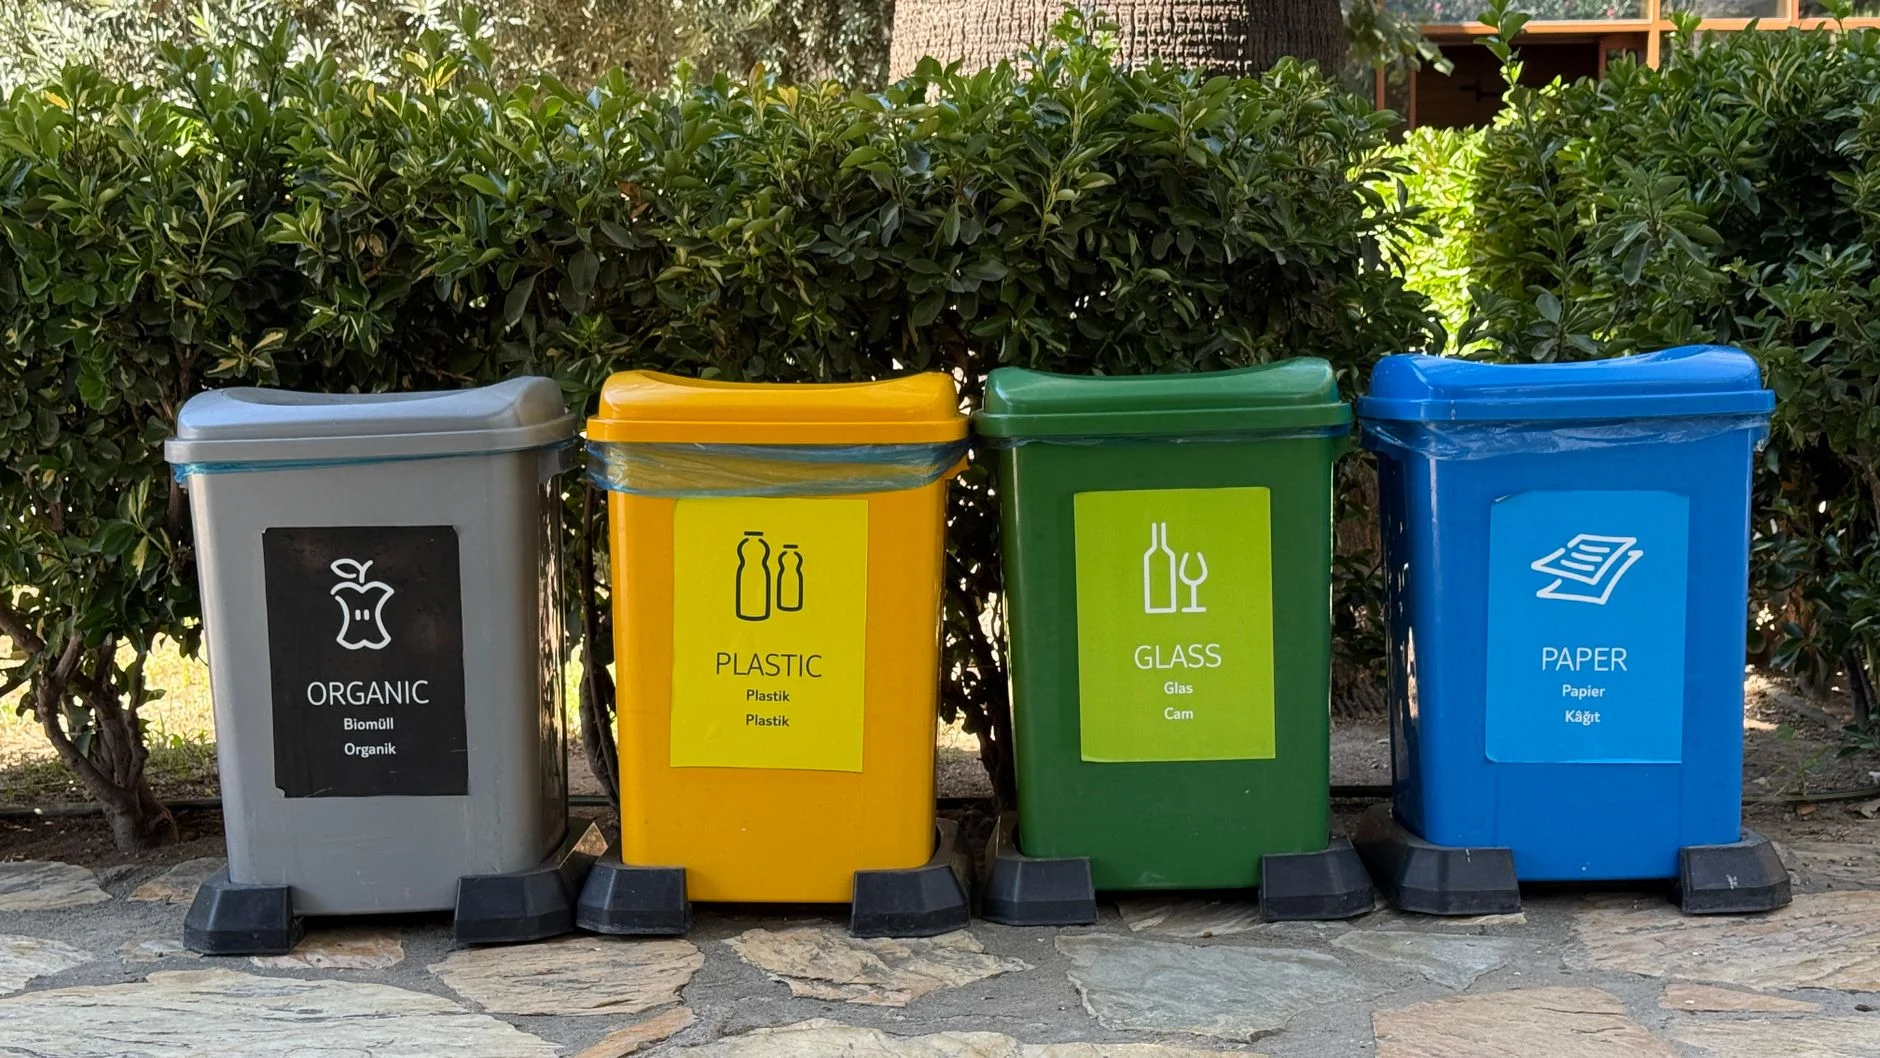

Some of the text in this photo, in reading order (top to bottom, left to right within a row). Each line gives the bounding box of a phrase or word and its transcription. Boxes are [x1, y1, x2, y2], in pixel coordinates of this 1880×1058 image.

[1134, 643, 1222, 670] GLASS
[1541, 646, 1628, 672] PAPER
[715, 652, 823, 678] PLASTIC
[307, 680, 430, 706] ORGANIC
[746, 689, 790, 702] Plastik
[1163, 681, 1193, 694] Glas
[1562, 684, 1606, 700] Papier
[745, 714, 790, 727] Plastik
[1164, 707, 1194, 720] Cam
[1564, 710, 1601, 726] Kâğıt
[343, 717, 394, 730] Biomüll
[344, 742, 397, 758] Organik
